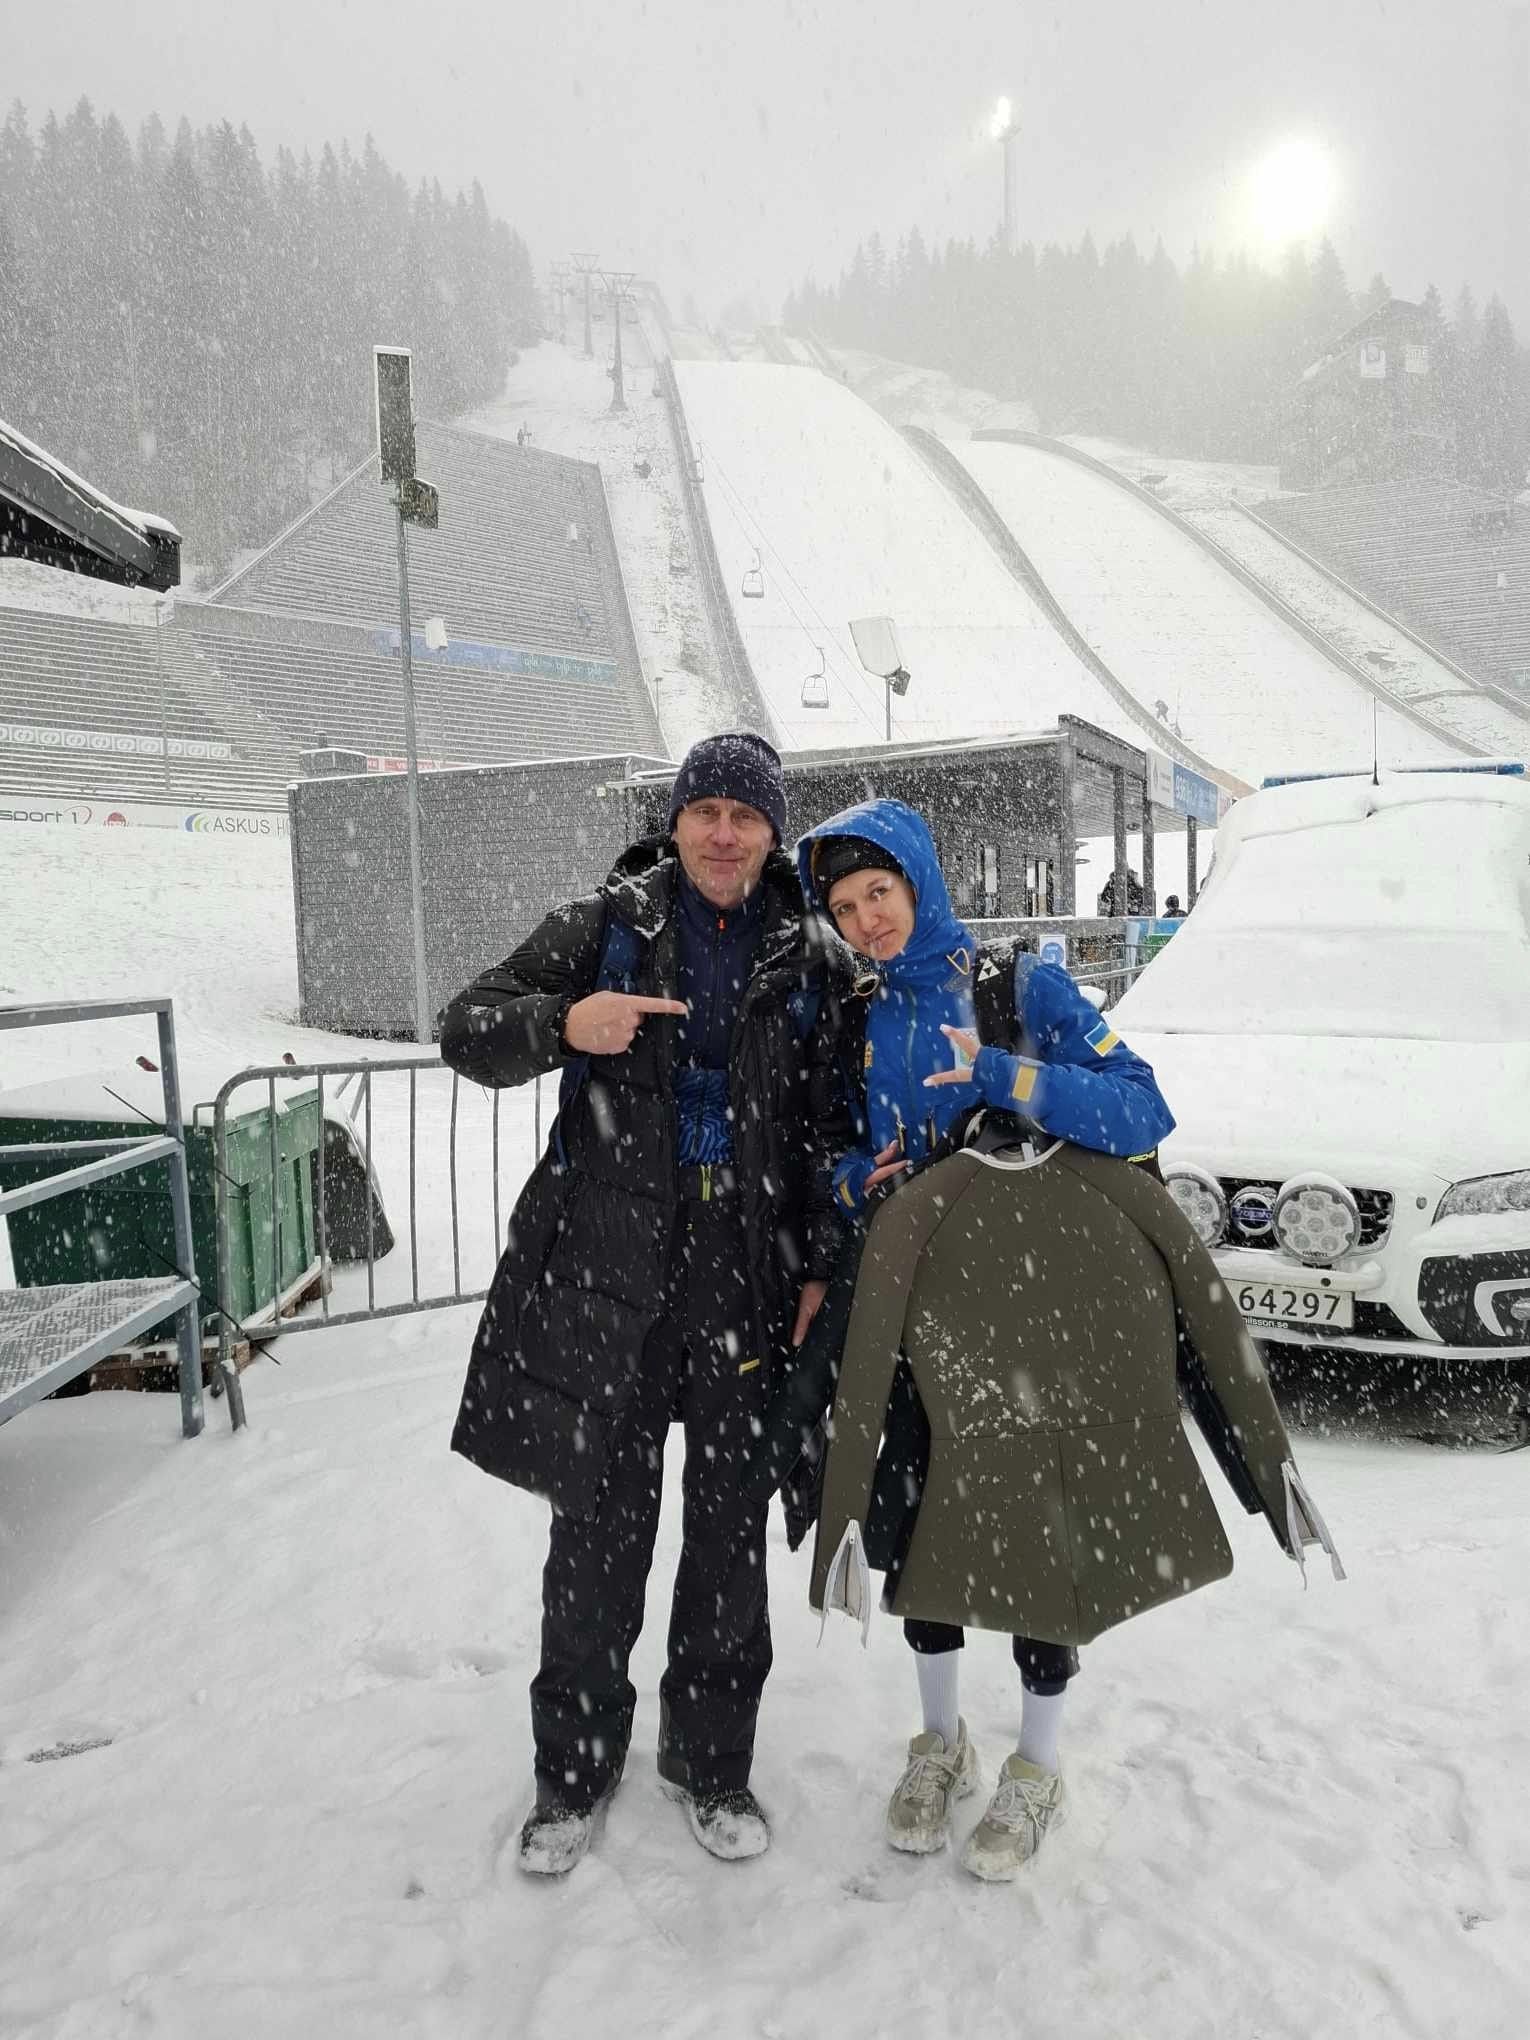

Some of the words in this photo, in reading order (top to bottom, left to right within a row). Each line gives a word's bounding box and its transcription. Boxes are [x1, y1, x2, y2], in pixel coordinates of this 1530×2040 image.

[0, 810, 62, 823] sport
[213, 816, 270, 834] ASKUS
[1238, 1286, 1340, 1321] 64297
